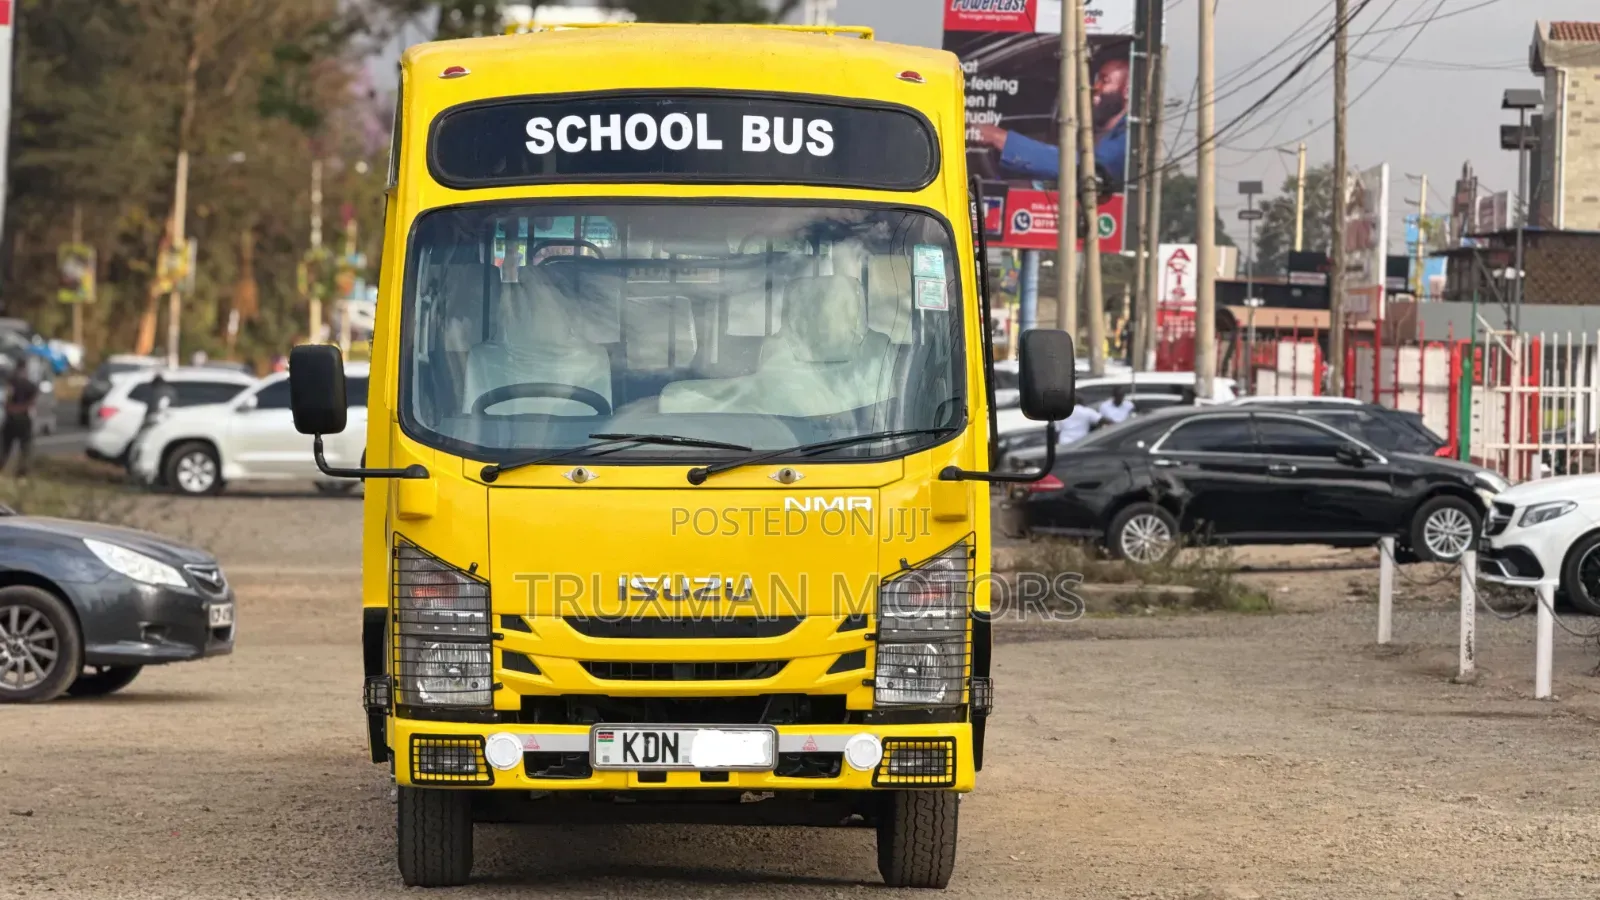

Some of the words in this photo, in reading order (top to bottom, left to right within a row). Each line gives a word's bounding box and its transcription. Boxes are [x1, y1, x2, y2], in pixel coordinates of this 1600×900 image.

[964, 76, 1018, 95] -feeling
[988, 93, 997, 107] it
[965, 110, 1002, 126] tually
[525, 112, 723, 155] SCHOOL
[742, 114, 834, 157] BUS
[784, 496, 873, 512] NMR
[617, 577, 753, 602] ISUZU
[623, 732, 679, 763] KDN
